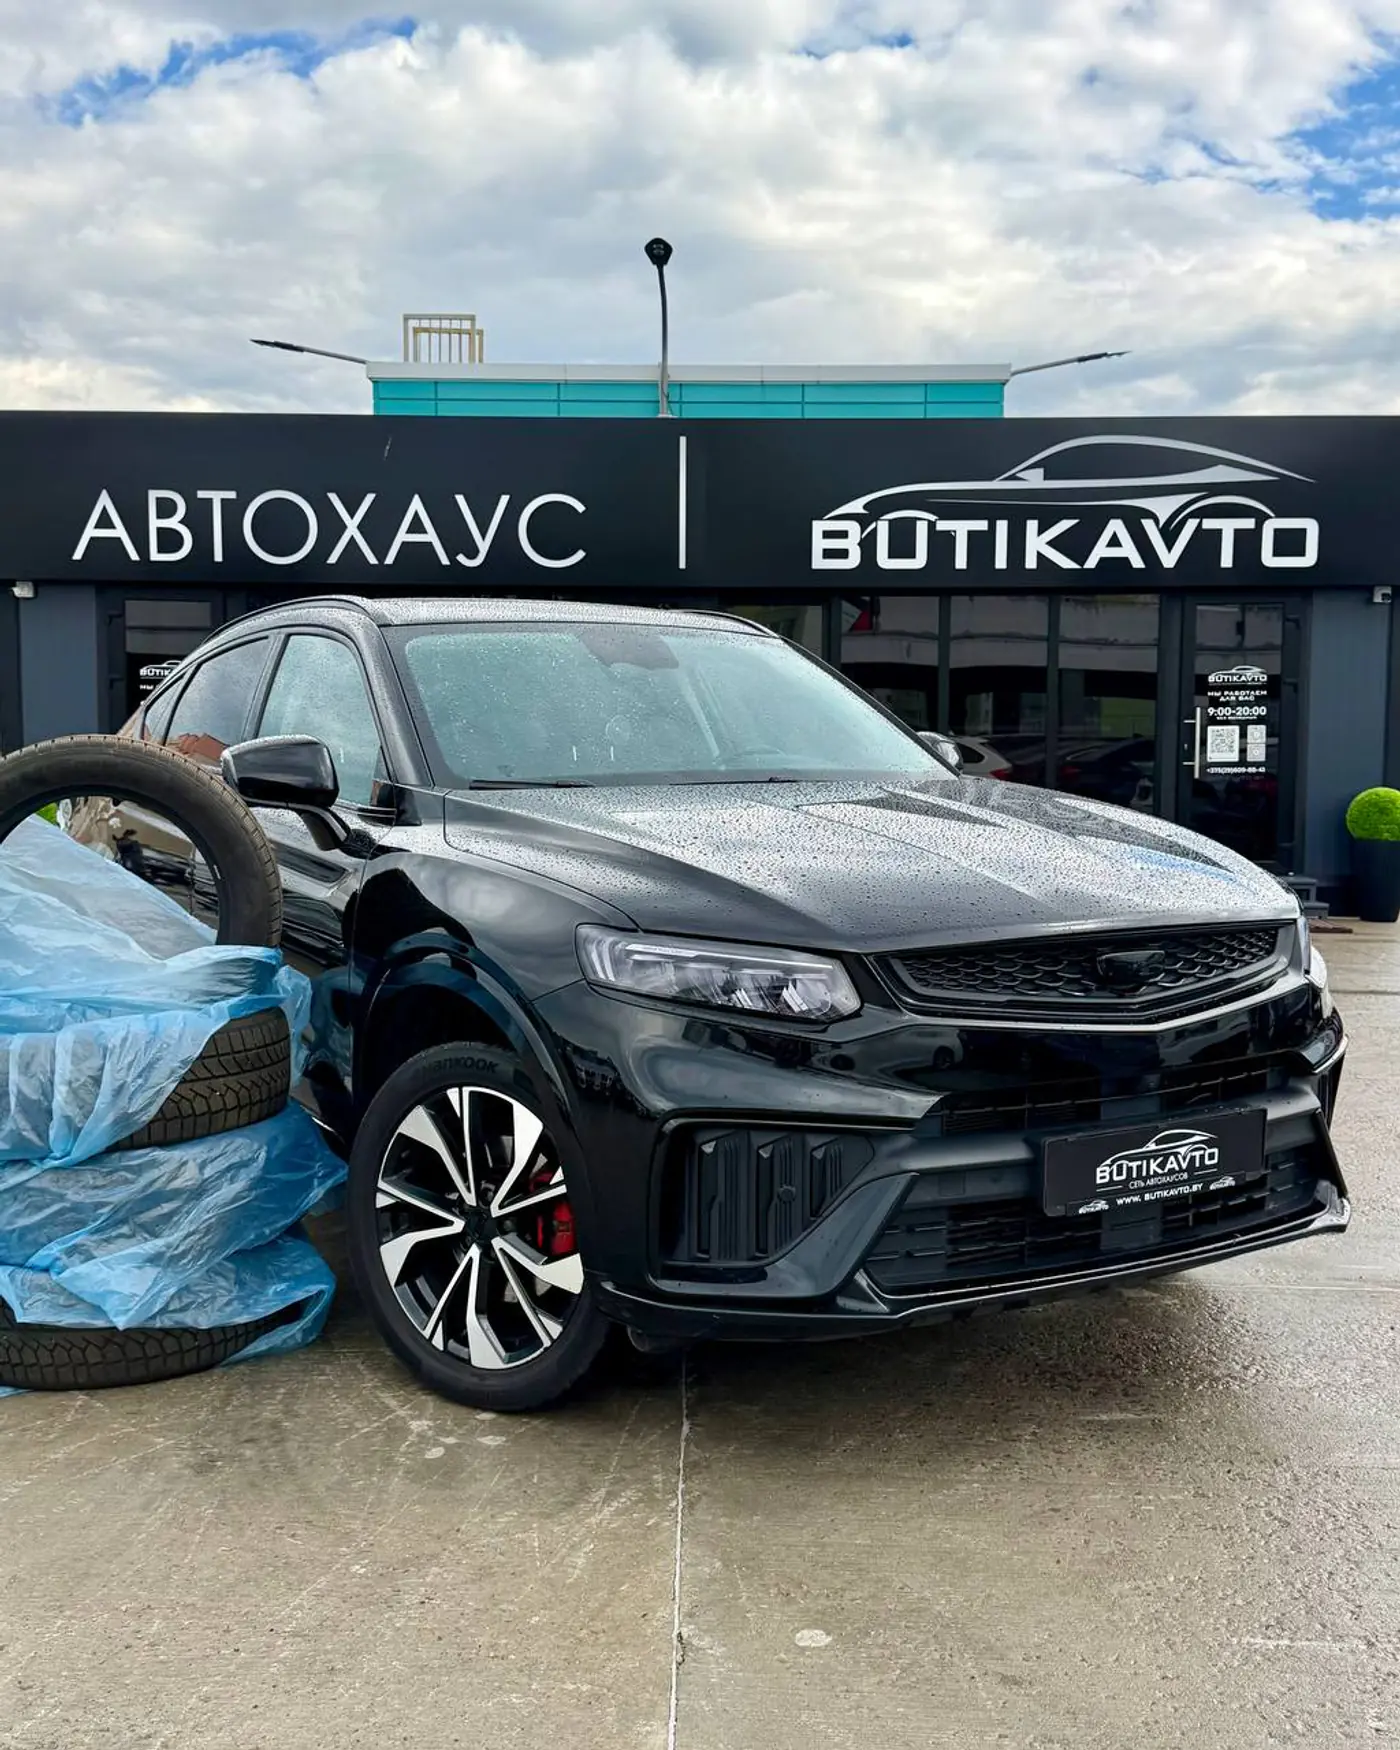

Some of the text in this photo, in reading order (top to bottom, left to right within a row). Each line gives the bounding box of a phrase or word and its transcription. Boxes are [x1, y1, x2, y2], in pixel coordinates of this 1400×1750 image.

[72, 488, 588, 569] АВТОХАУС
[811, 517, 1319, 570] BUTIKAVTO
[1208, 674, 1268, 682] BUTIKAVTO
[1207, 706, 1267, 716] 9:00-20:00
[1096, 1147, 1219, 1184] BUTIKAVTO
[1146, 1172, 1189, 1187] АВТОХАУСОВ
